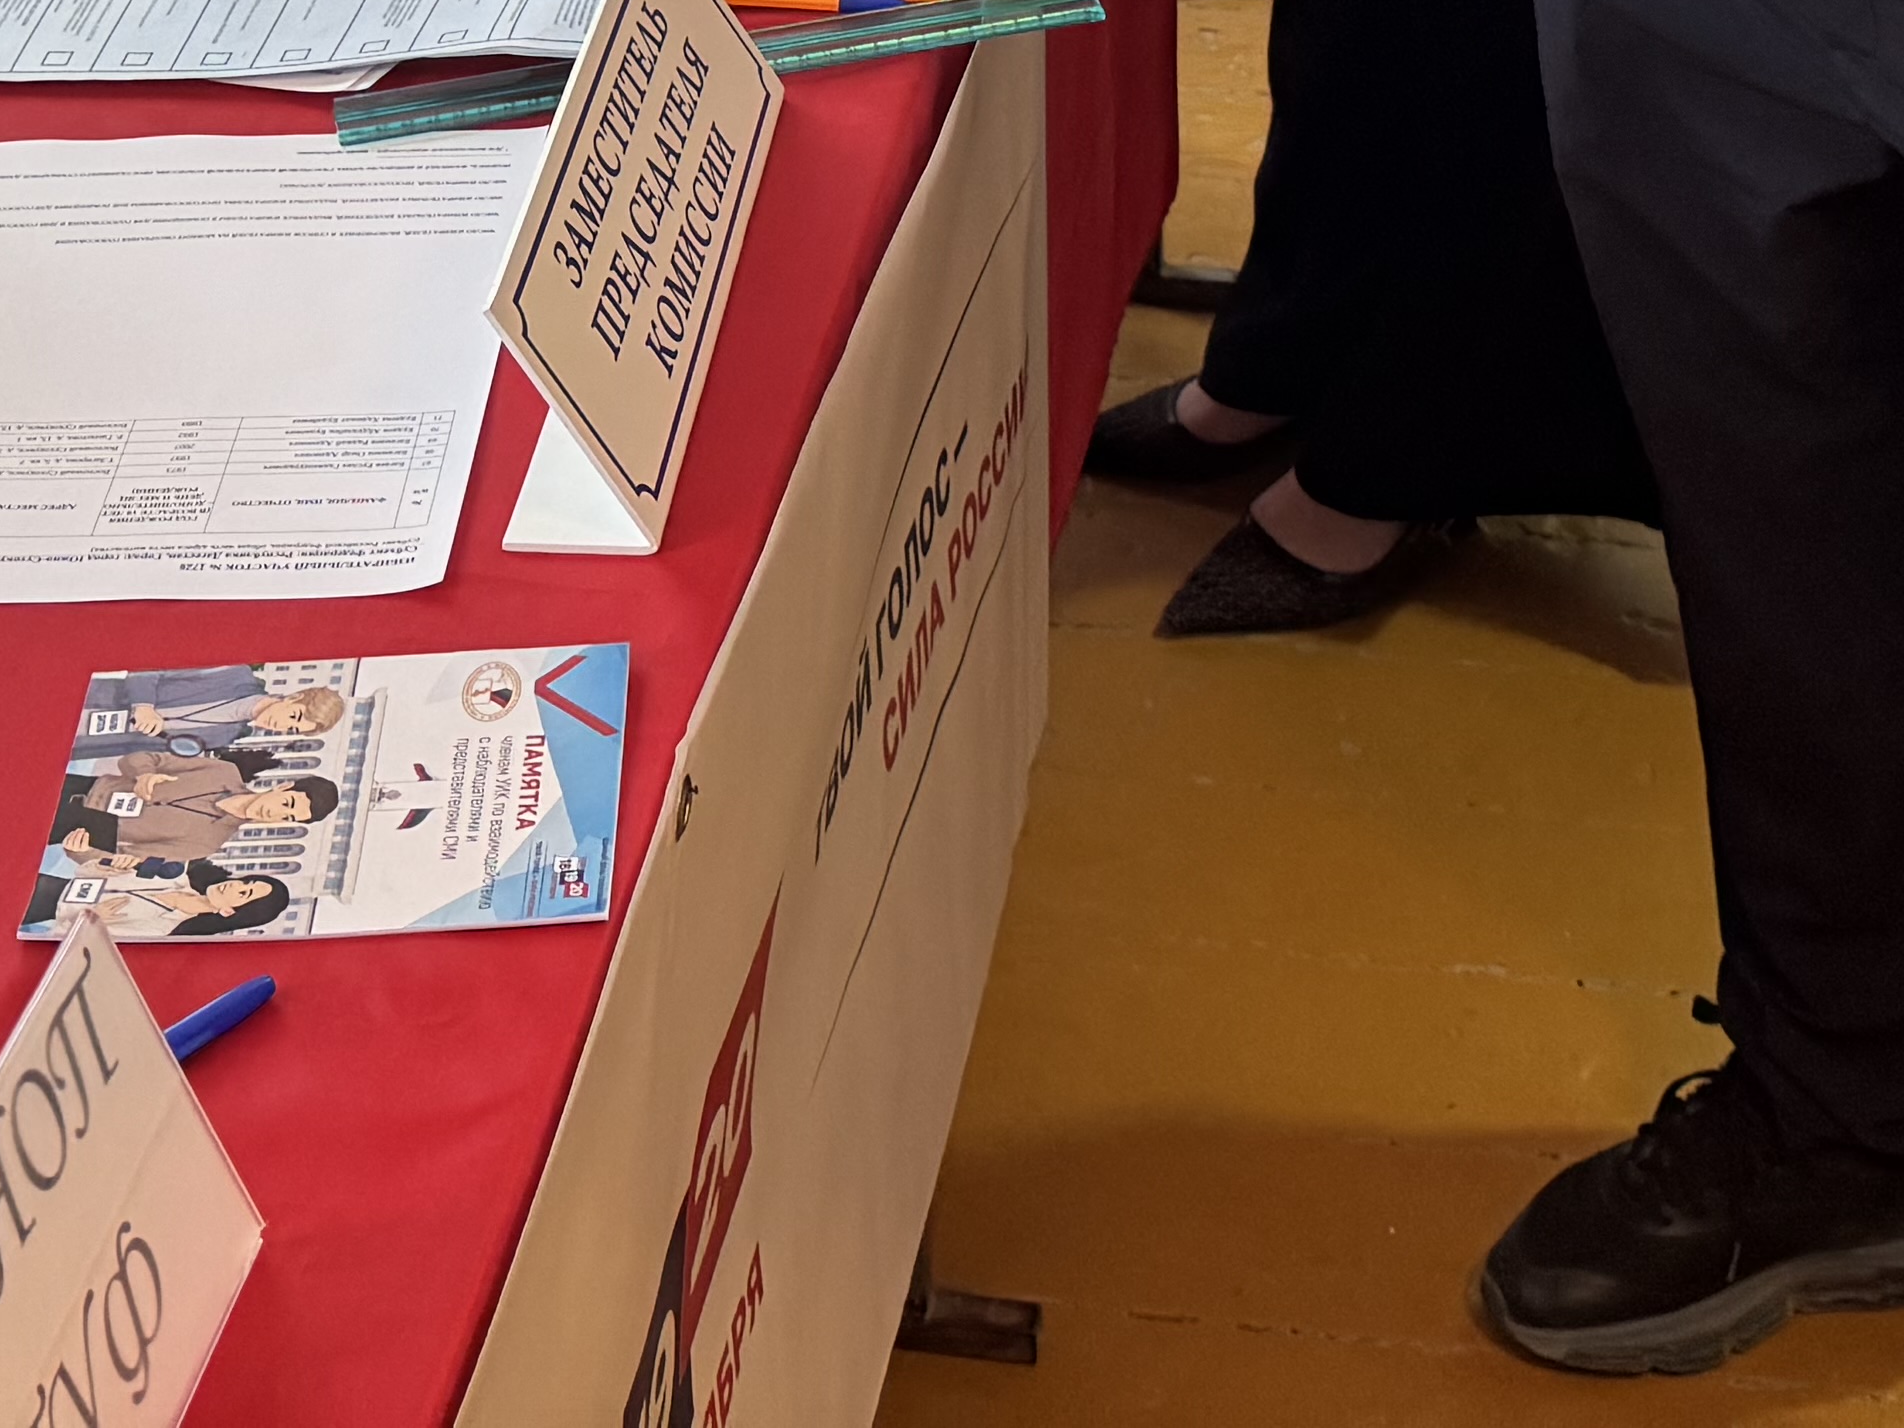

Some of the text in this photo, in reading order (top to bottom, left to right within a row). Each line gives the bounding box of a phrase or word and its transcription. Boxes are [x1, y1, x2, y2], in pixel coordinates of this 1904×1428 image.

[551, 0, 669, 291] ЗАМЕСТИТЕЛЬ
[590, 35, 711, 363] ПРЕДСЕДАТЕЛЯ
[645, 120, 737, 379] КОМИССИИ
[223, 560, 291, 571] УЧАСТОК
[290, 555, 416, 569] ИЗБИРАТЕЛЬНЫЙ
[813, 652, 876, 865] ТВОЙ
[874, 446, 951, 683] ГОЛОС
[880, 600, 946, 775] СИЛА
[439, 737, 472, 860] представителями СМИ
[465, 745, 493, 833] наблюдателями
[489, 802, 506, 817] по
[492, 777, 512, 800] УИК
[514, 734, 546, 831] ПАМЯТКА
[464, 834, 480, 843] и
[567, 883, 584, 897] 20
[689, 1012, 758, 1296] 20
